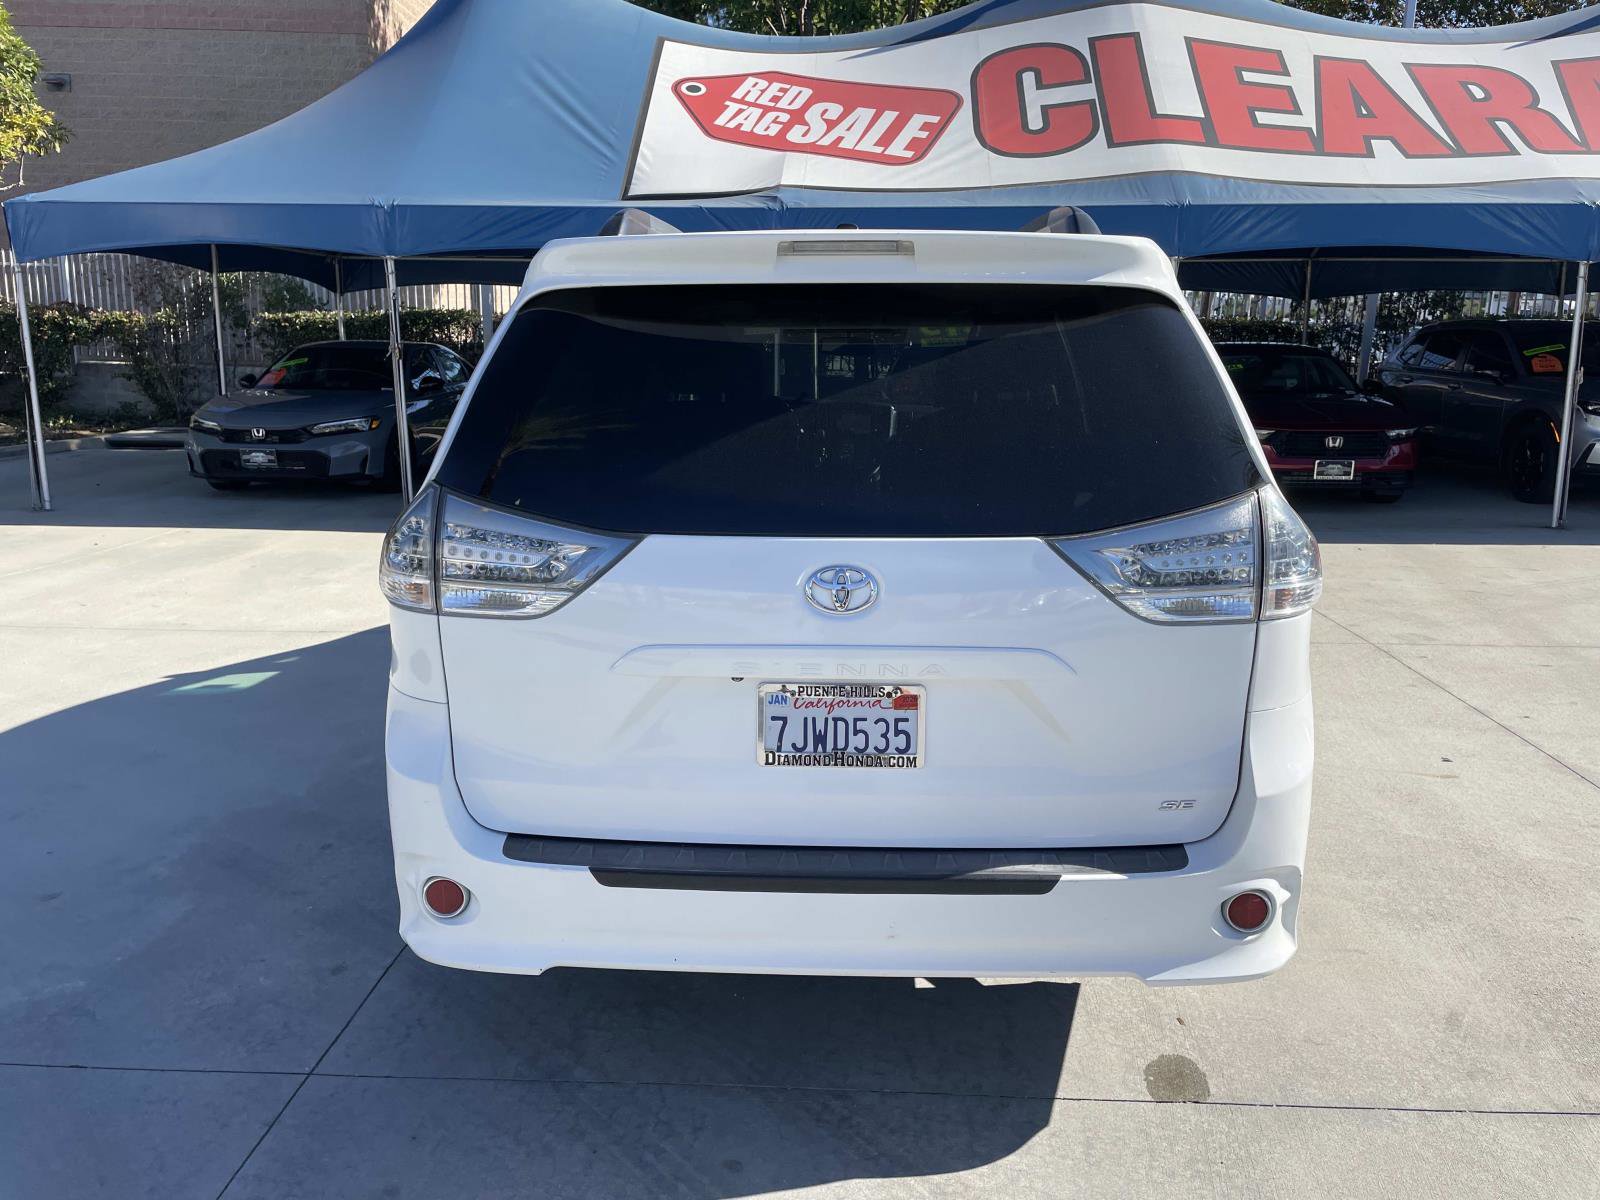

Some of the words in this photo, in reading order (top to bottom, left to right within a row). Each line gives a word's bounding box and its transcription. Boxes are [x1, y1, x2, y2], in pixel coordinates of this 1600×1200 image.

[730, 76, 813, 111] RED
[713, 100, 791, 137] TAG
[785, 102, 941, 158] SALE
[732, 660, 946, 677] SENNA
[768, 694, 788, 705] JAN
[797, 685, 845, 697] PUENTE
[851, 686, 886, 698] HILLS
[793, 697, 883, 715] California
[770, 715, 912, 754] 7JWD535
[1158, 800, 1196, 811] SE
